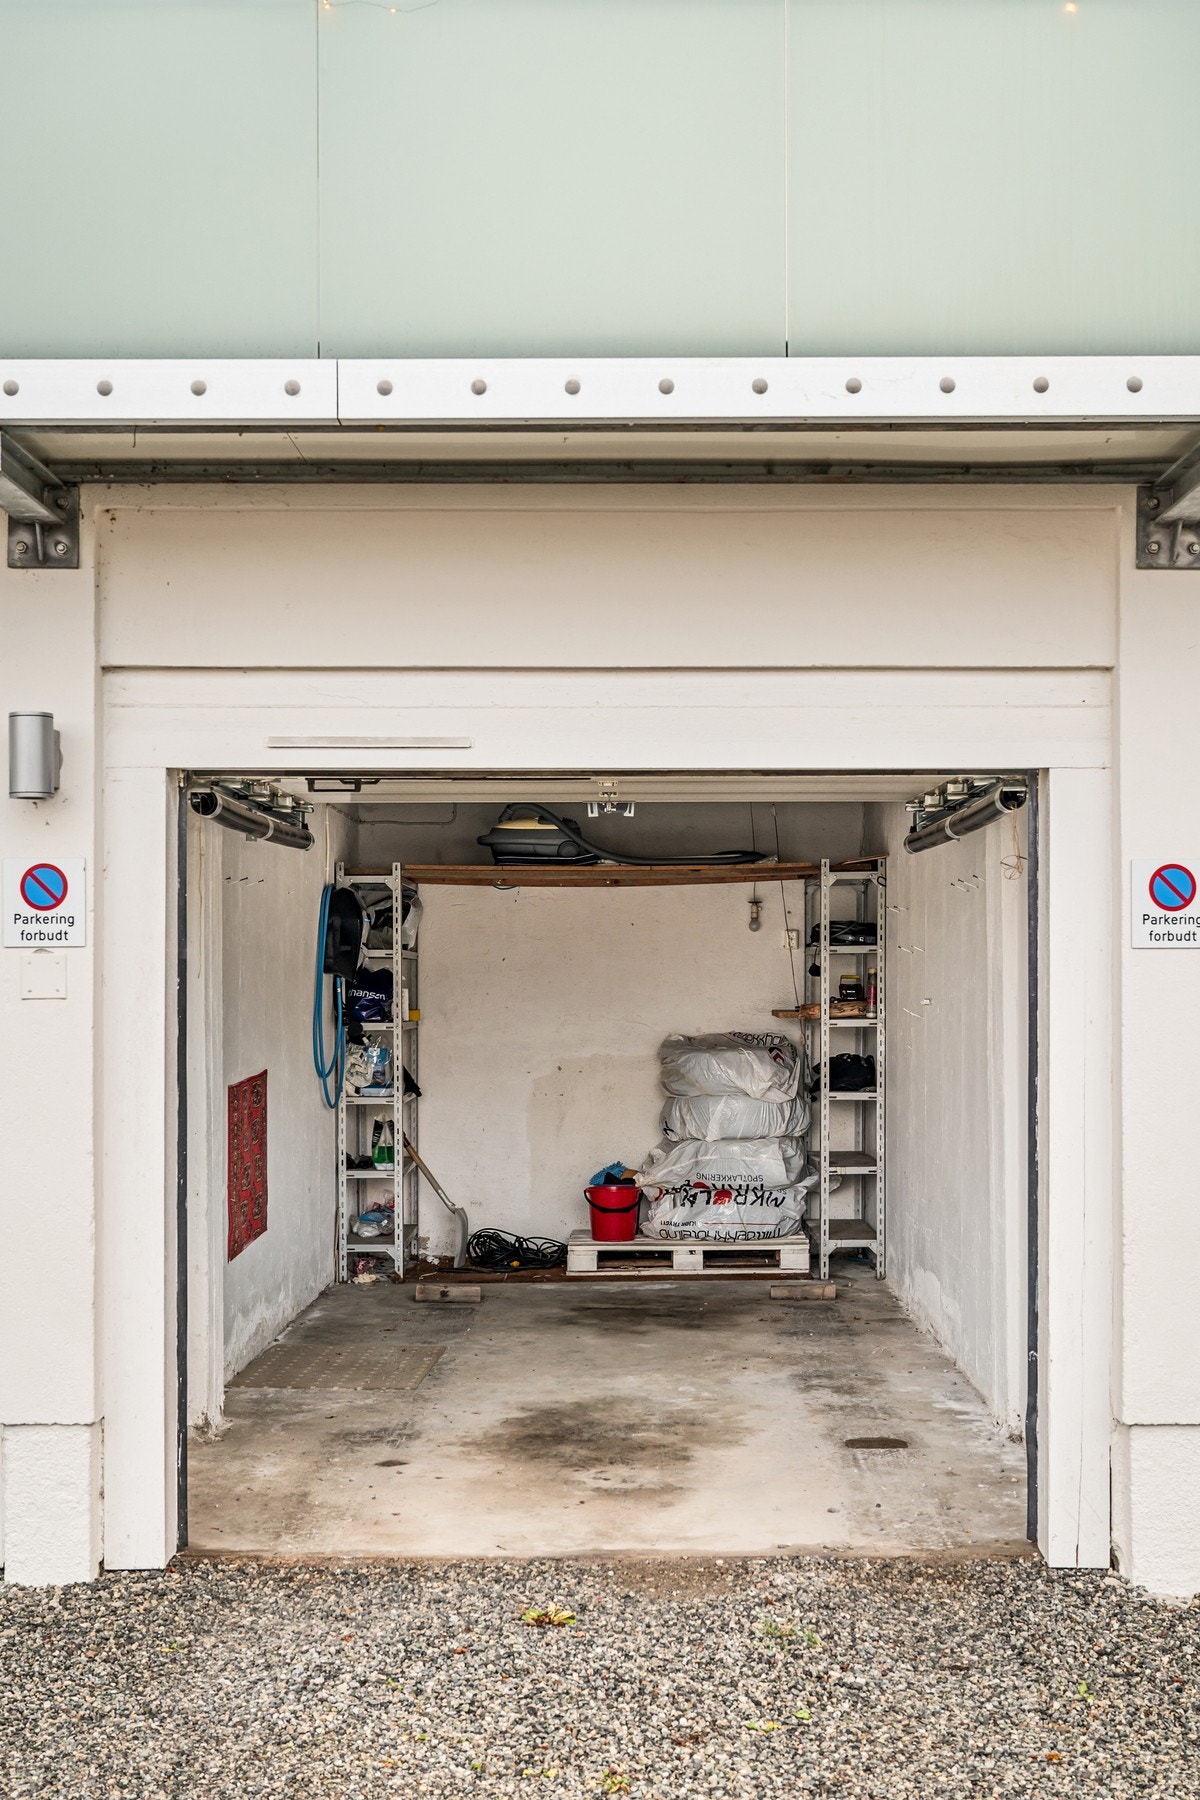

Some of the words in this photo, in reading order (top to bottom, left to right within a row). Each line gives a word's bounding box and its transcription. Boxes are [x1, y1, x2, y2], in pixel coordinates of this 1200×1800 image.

[14, 913, 75, 927] Parkering
[20, 930, 69, 941] forbudt
[1149, 930, 1197, 942] forbudt
[696, 1172, 764, 1183] SPOTLAKKERING
